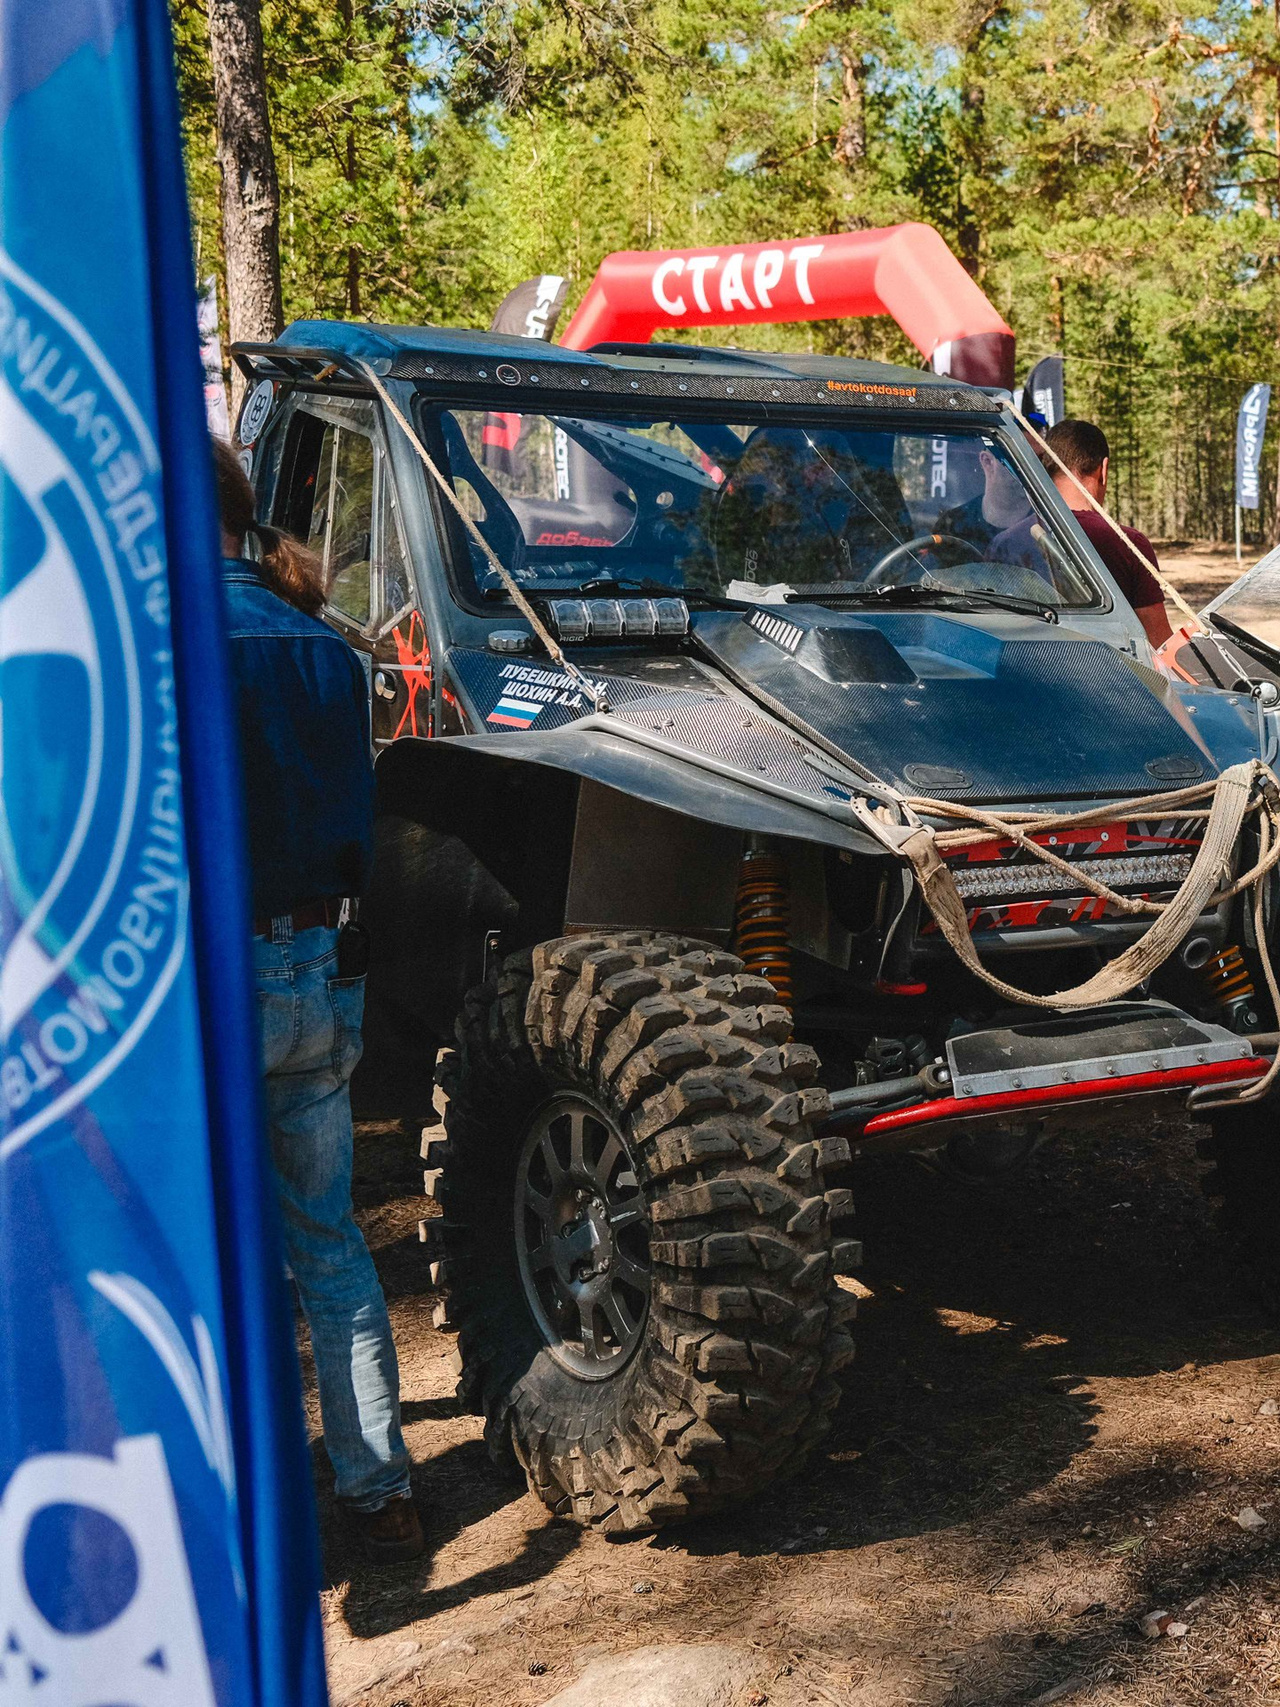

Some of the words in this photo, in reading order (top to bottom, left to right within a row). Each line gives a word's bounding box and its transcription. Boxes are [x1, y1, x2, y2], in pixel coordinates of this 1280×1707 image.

[652, 244, 825, 316] СТАРТ
[827, 380, 917, 397] #avtokotdosaaf
[745, 548, 758, 581] spa
[501, 681, 558, 703] ШОХИН
